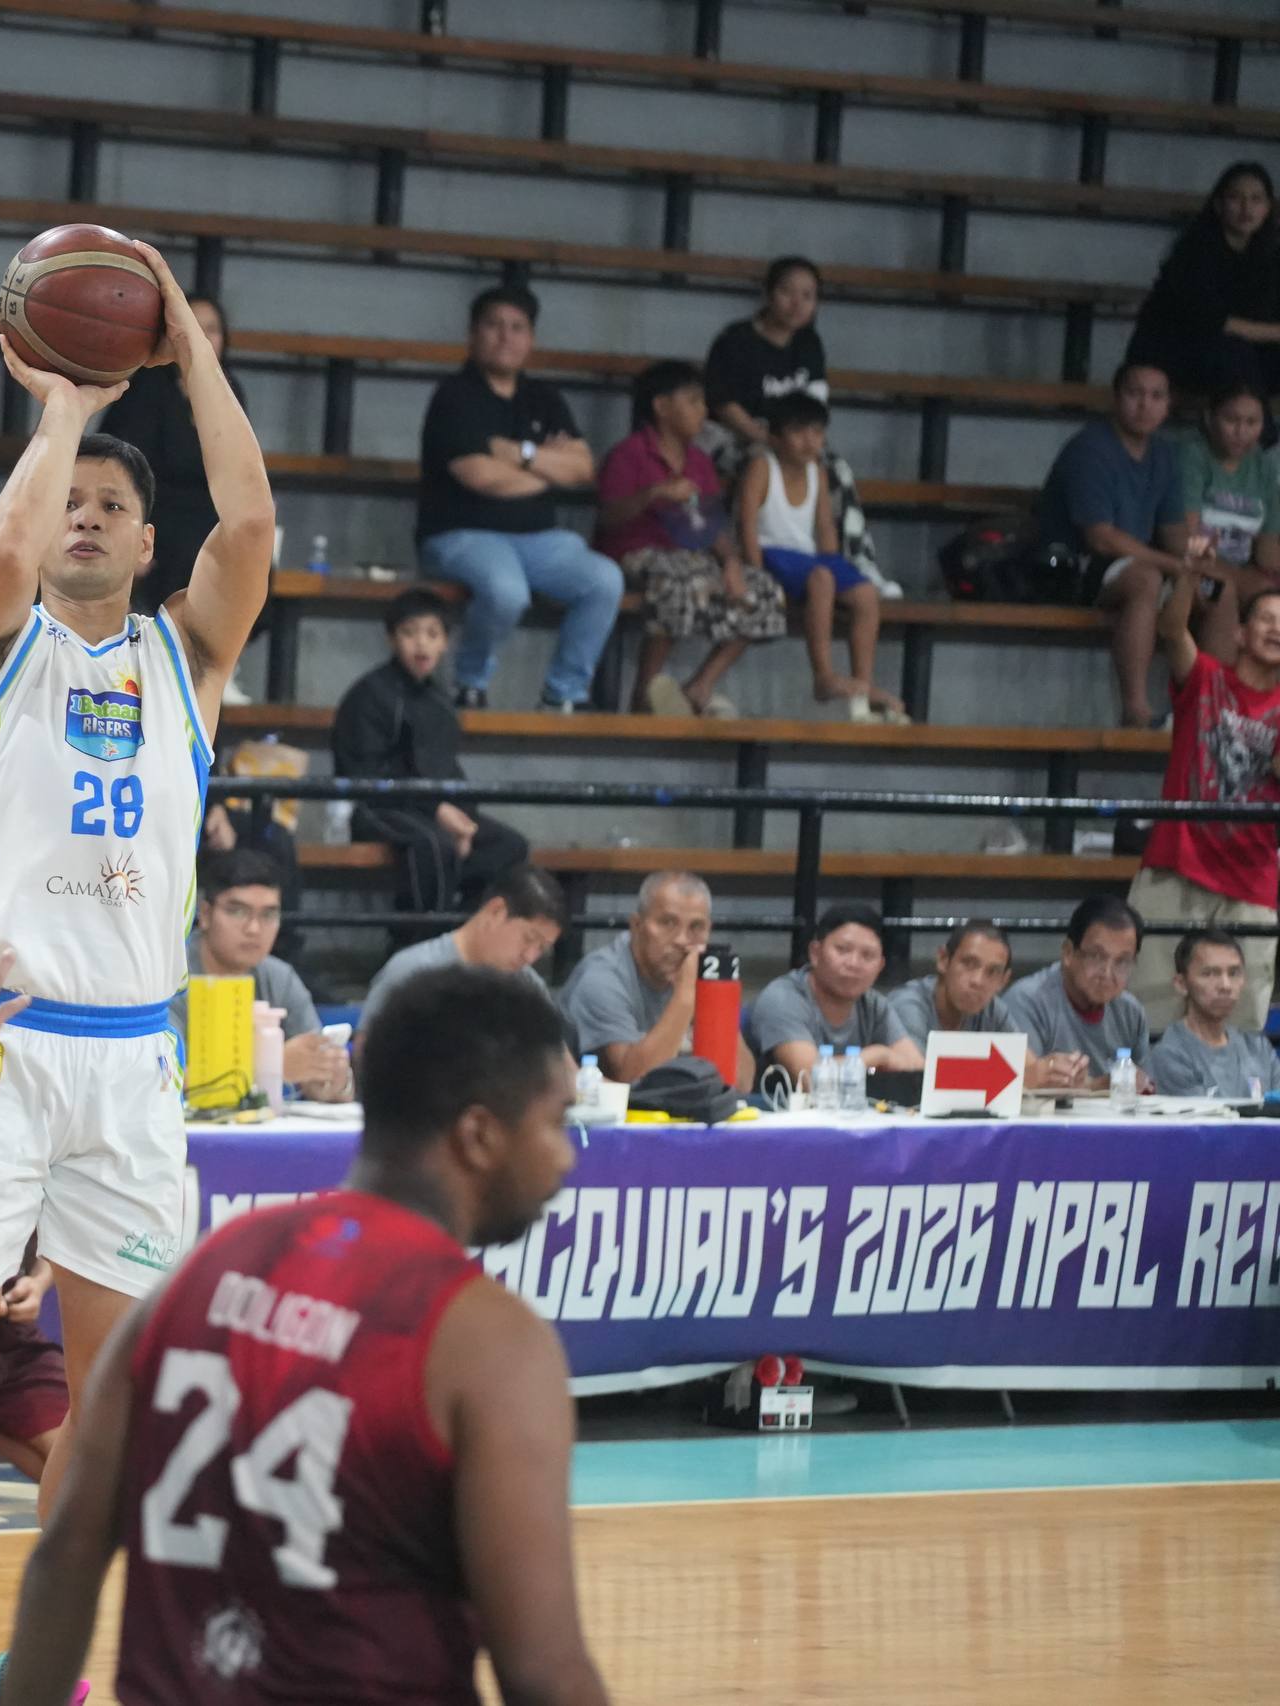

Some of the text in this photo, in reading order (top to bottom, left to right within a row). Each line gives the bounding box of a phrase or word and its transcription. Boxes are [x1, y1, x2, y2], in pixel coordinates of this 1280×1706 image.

[83, 717, 132, 738] RISERS
[71, 771, 144, 838] 28
[703, 956, 720, 979] 2
[833, 1182, 998, 1316] 2026
[997, 1181, 1159, 1309] MPBL
[142, 1348, 354, 1590] 24
